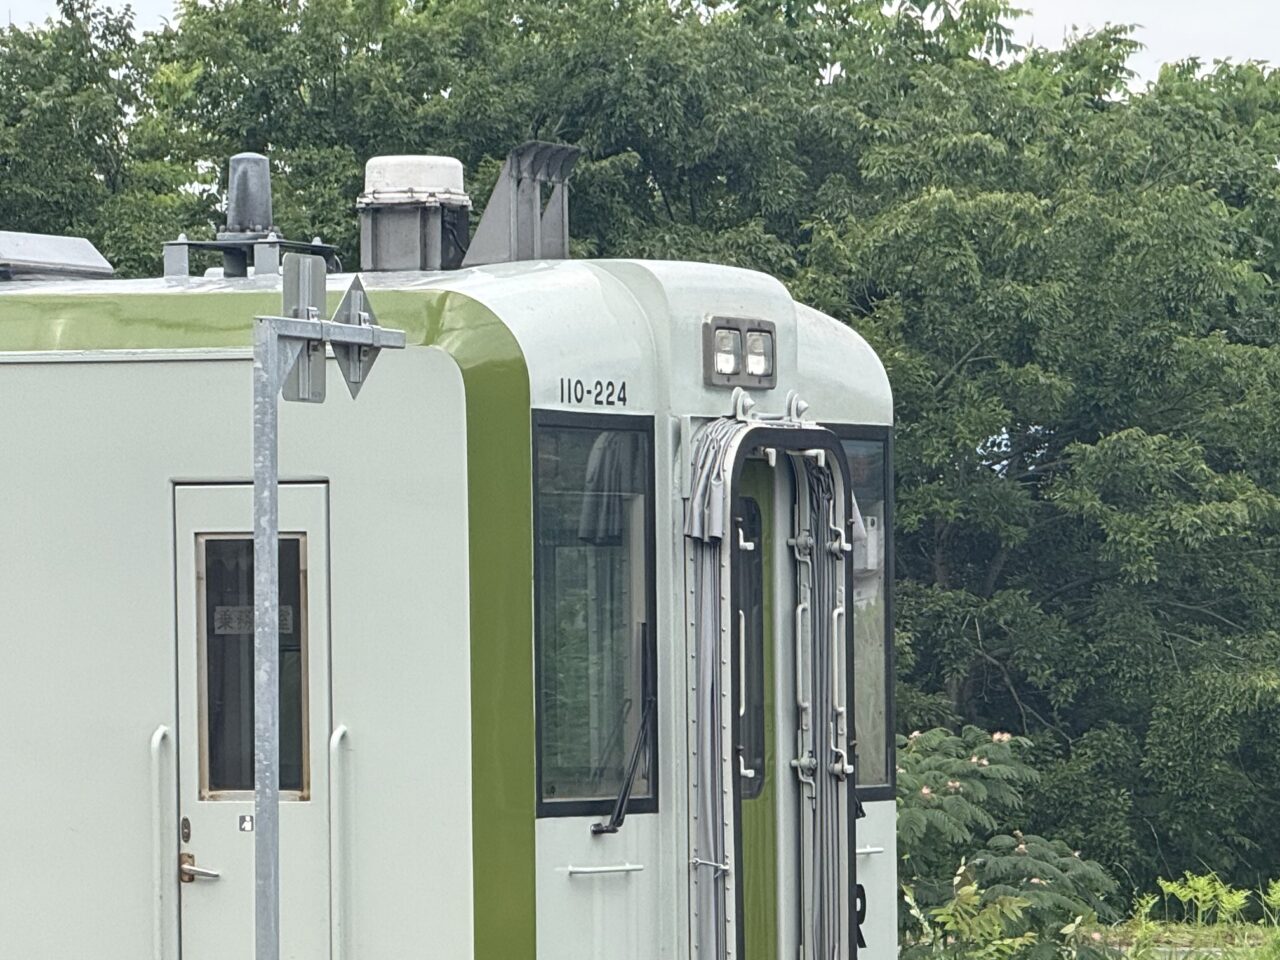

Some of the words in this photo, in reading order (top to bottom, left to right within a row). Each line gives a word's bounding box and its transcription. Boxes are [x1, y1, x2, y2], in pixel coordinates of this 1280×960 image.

[560, 377, 627, 406] 110-224
[217, 607, 291, 631] 乗務室
